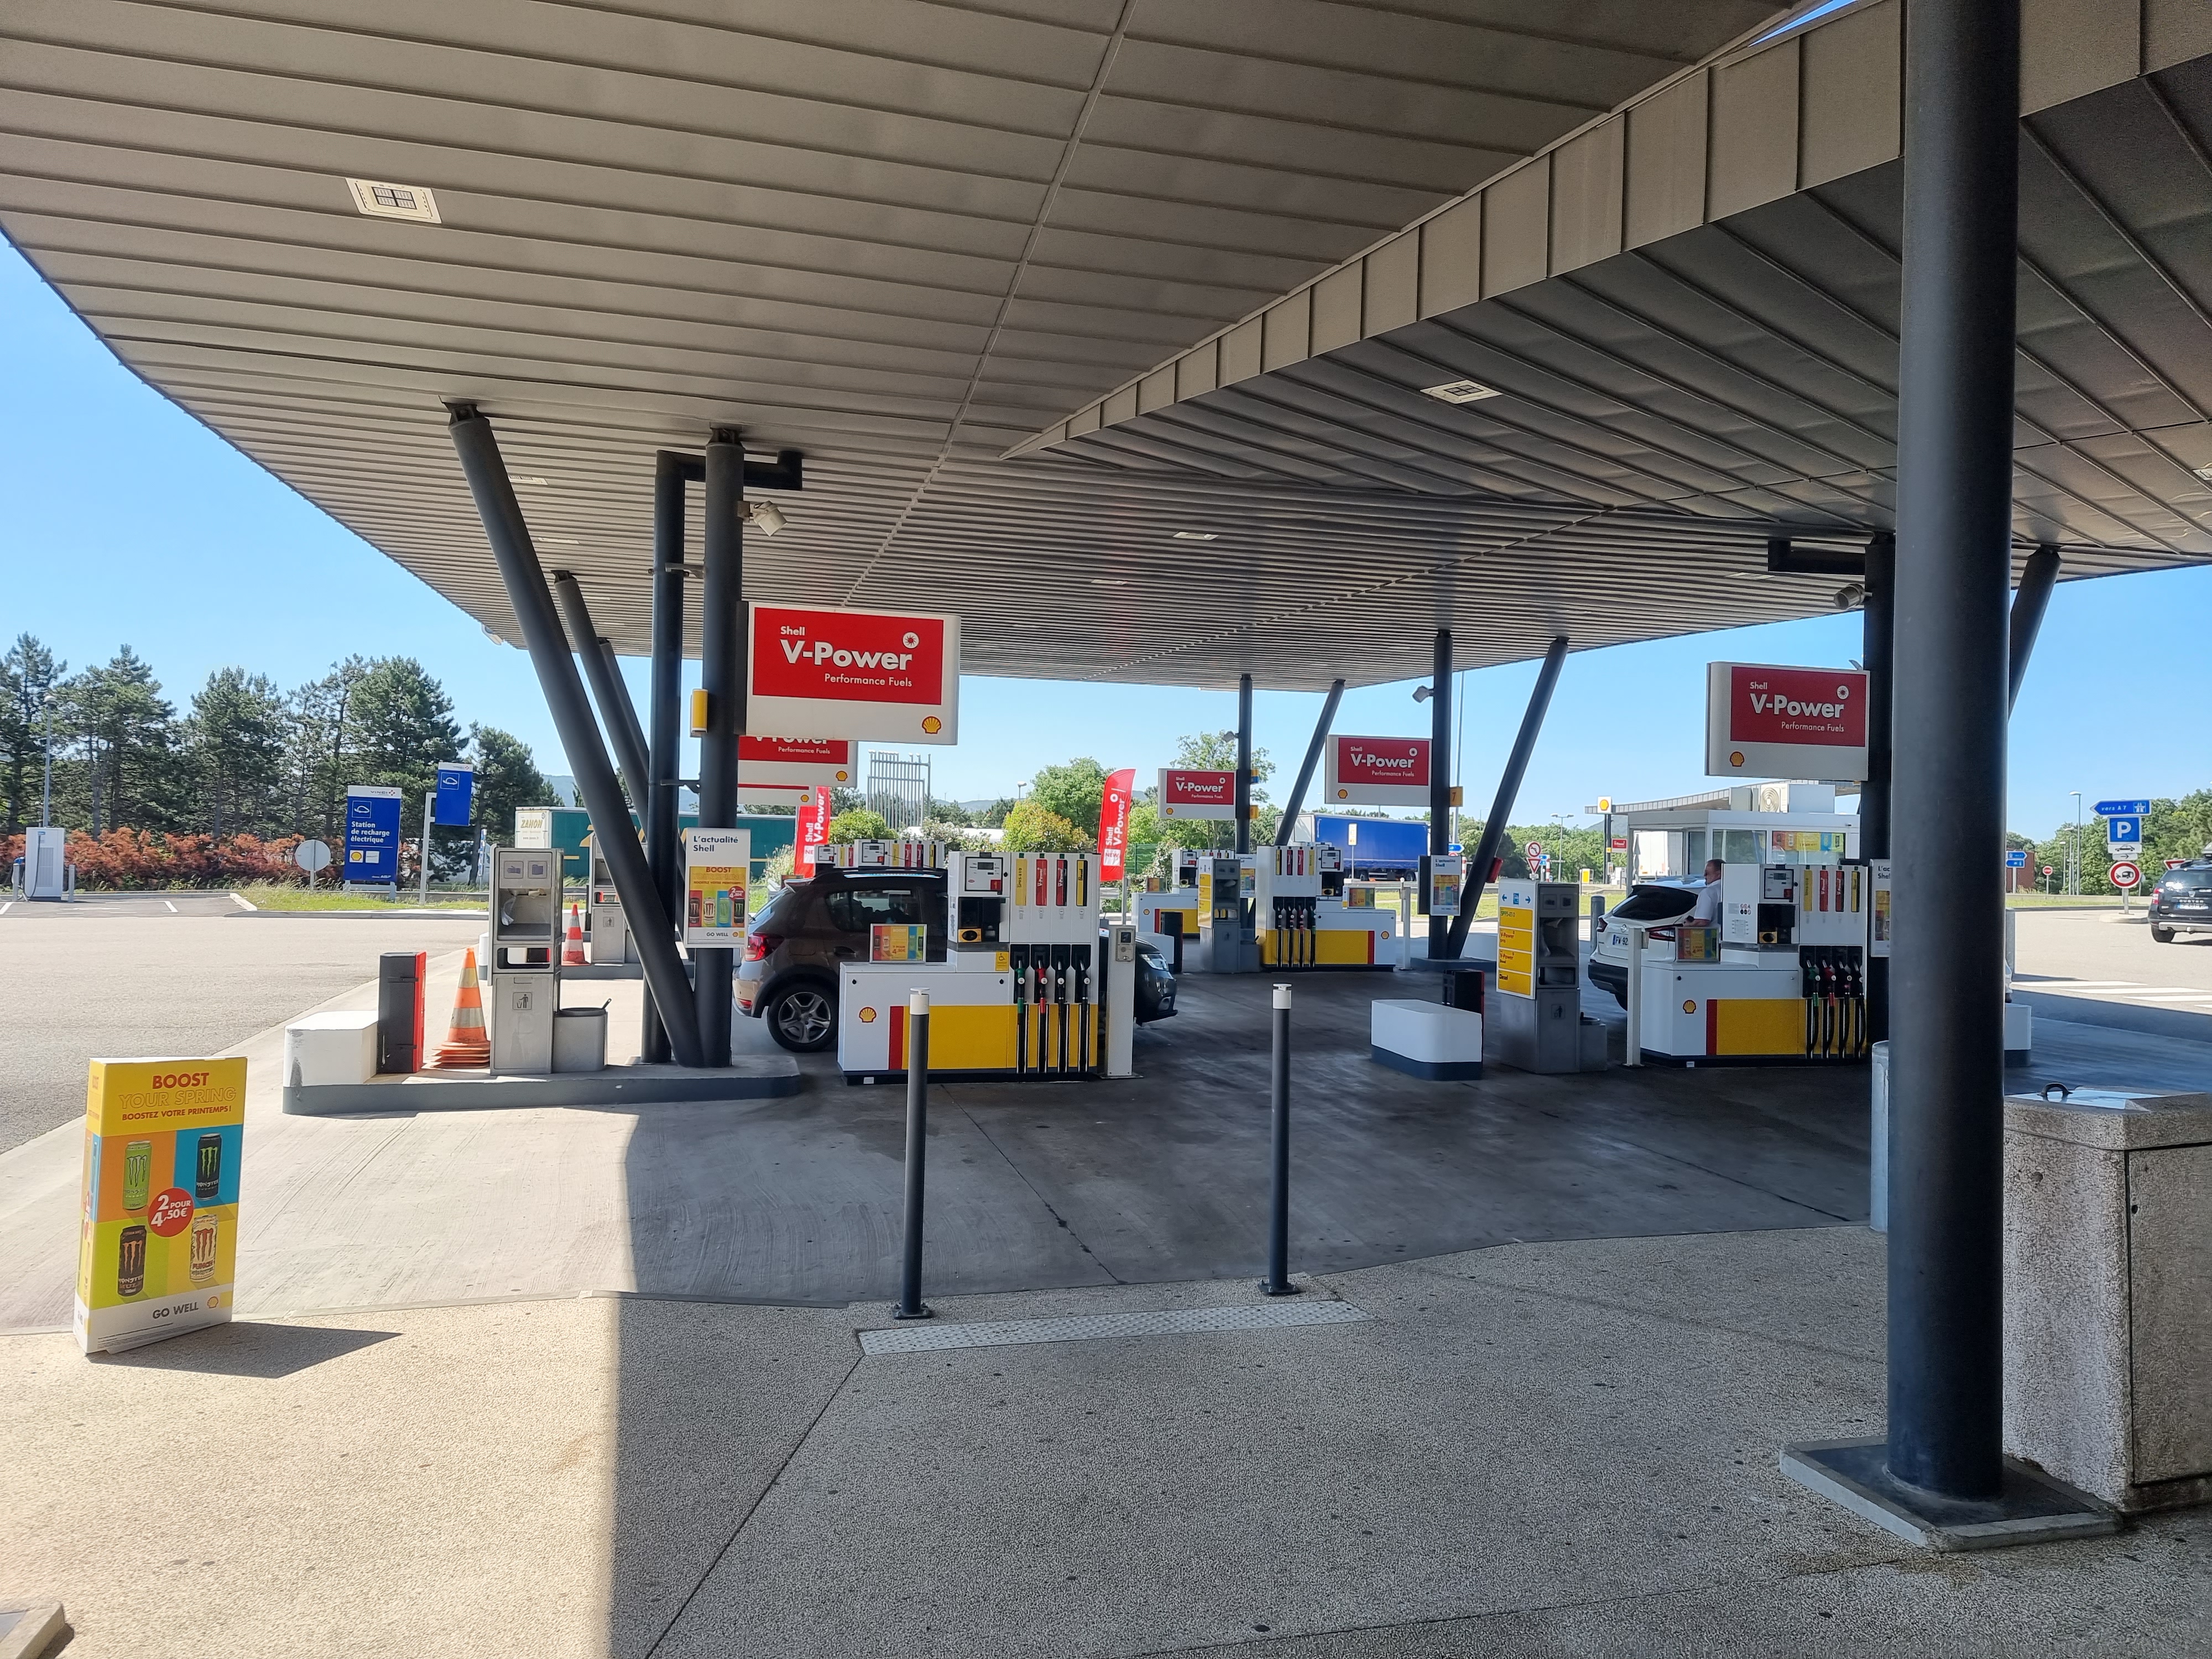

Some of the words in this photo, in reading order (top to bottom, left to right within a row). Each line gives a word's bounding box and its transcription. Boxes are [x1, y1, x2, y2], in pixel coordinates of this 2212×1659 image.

[780, 625, 806, 636] Shell
[780, 639, 913, 670] V-Power
[824, 673, 886, 686] Performance
[888, 677, 913, 687] Fuels
[1750, 681, 1768, 690] Shell
[1749, 693, 1845, 718] V-Power
[1781, 721, 1825, 731] Performance
[1827, 723, 1845, 733] Fuels
[1350, 753, 1415, 768] V-Power
[1175, 781, 1223, 792] V-Power
[1452, 792, 1457, 802] 7
[813, 793, 825, 843] V-Power
[1113, 797, 1125, 846] V-Power
[805, 822, 814, 843] Shell
[1105, 827, 1114, 846] Shell
[2117, 821, 2132, 838] P
[350, 836, 384, 844] électrique
[152, 1072, 210, 1089] BOOST
[118, 1091, 169, 1109] YOUR
[175, 1087, 237, 1105] SPRING
[122, 1111, 159, 1121] BOOSTEZ
[157, 1194, 169, 1211] 2
[150, 1207, 187, 1227] 4,50€
[152, 1308, 170, 1319] GO
[173, 1301, 199, 1315] WELL
